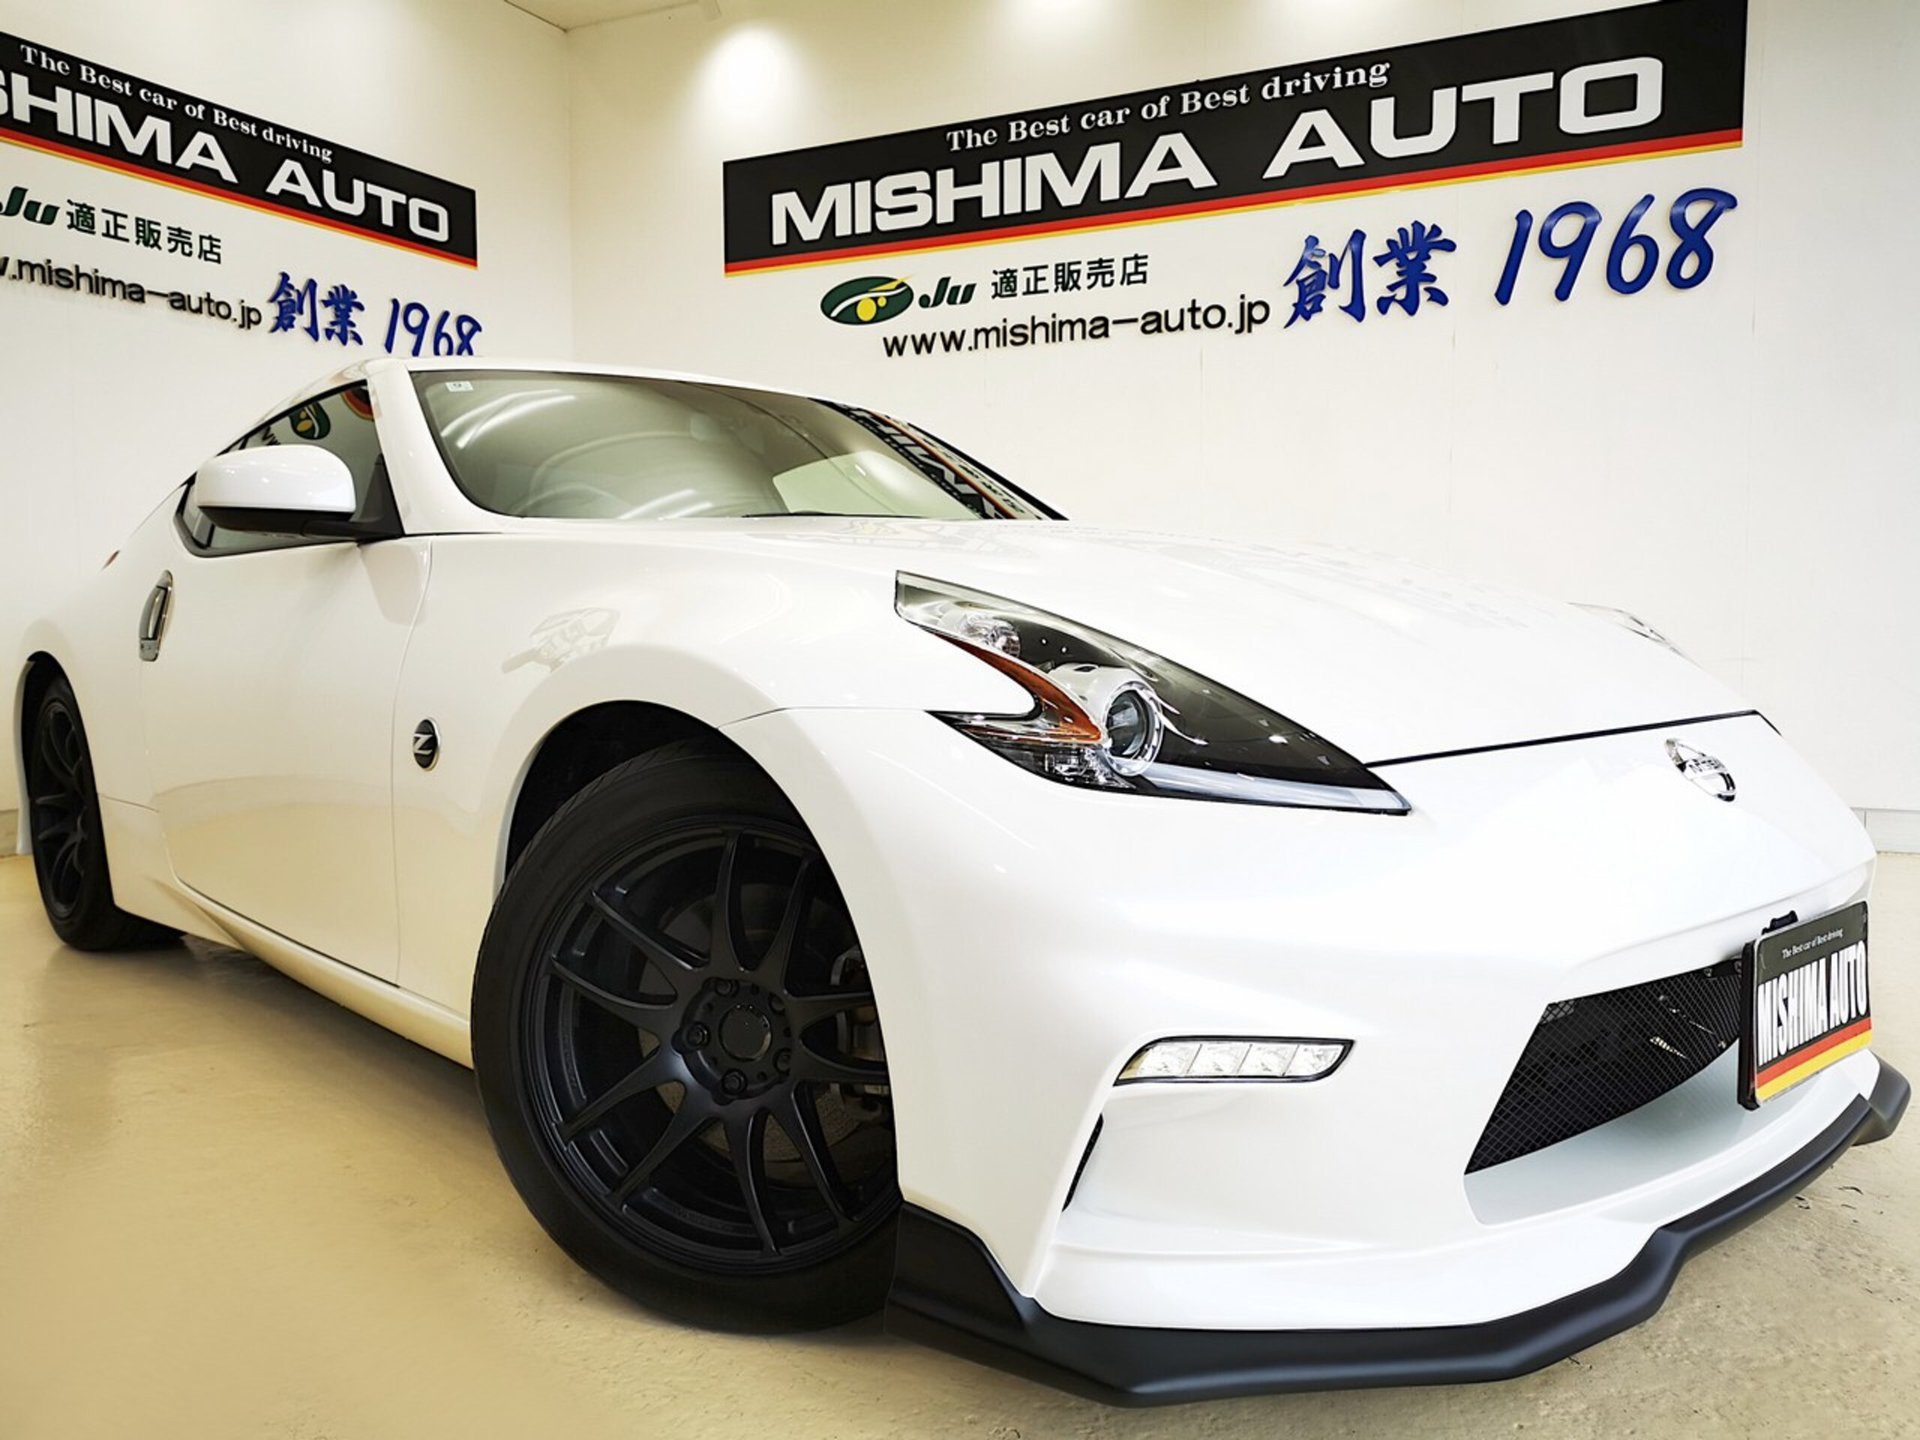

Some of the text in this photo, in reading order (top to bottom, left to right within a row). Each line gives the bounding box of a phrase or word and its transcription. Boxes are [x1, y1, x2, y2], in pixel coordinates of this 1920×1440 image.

[20, 44, 333, 163] The Best car of Best driving
[946, 62, 1390, 151] The Best car of Best driving
[771, 56, 1663, 246] MISHIMA AUTO
[66, 199, 223, 265] 適正販売店
[266, 158, 450, 243] AUTO
[991, 253, 1149, 300] 適正販売店
[1283, 188, 1738, 329] 創業 1968
[268, 272, 483, 356] 創業 1968
[883, 293, 1271, 358] www.mishima-auto.jp
[1757, 940, 1867, 1067] MISHIMA AUTO
